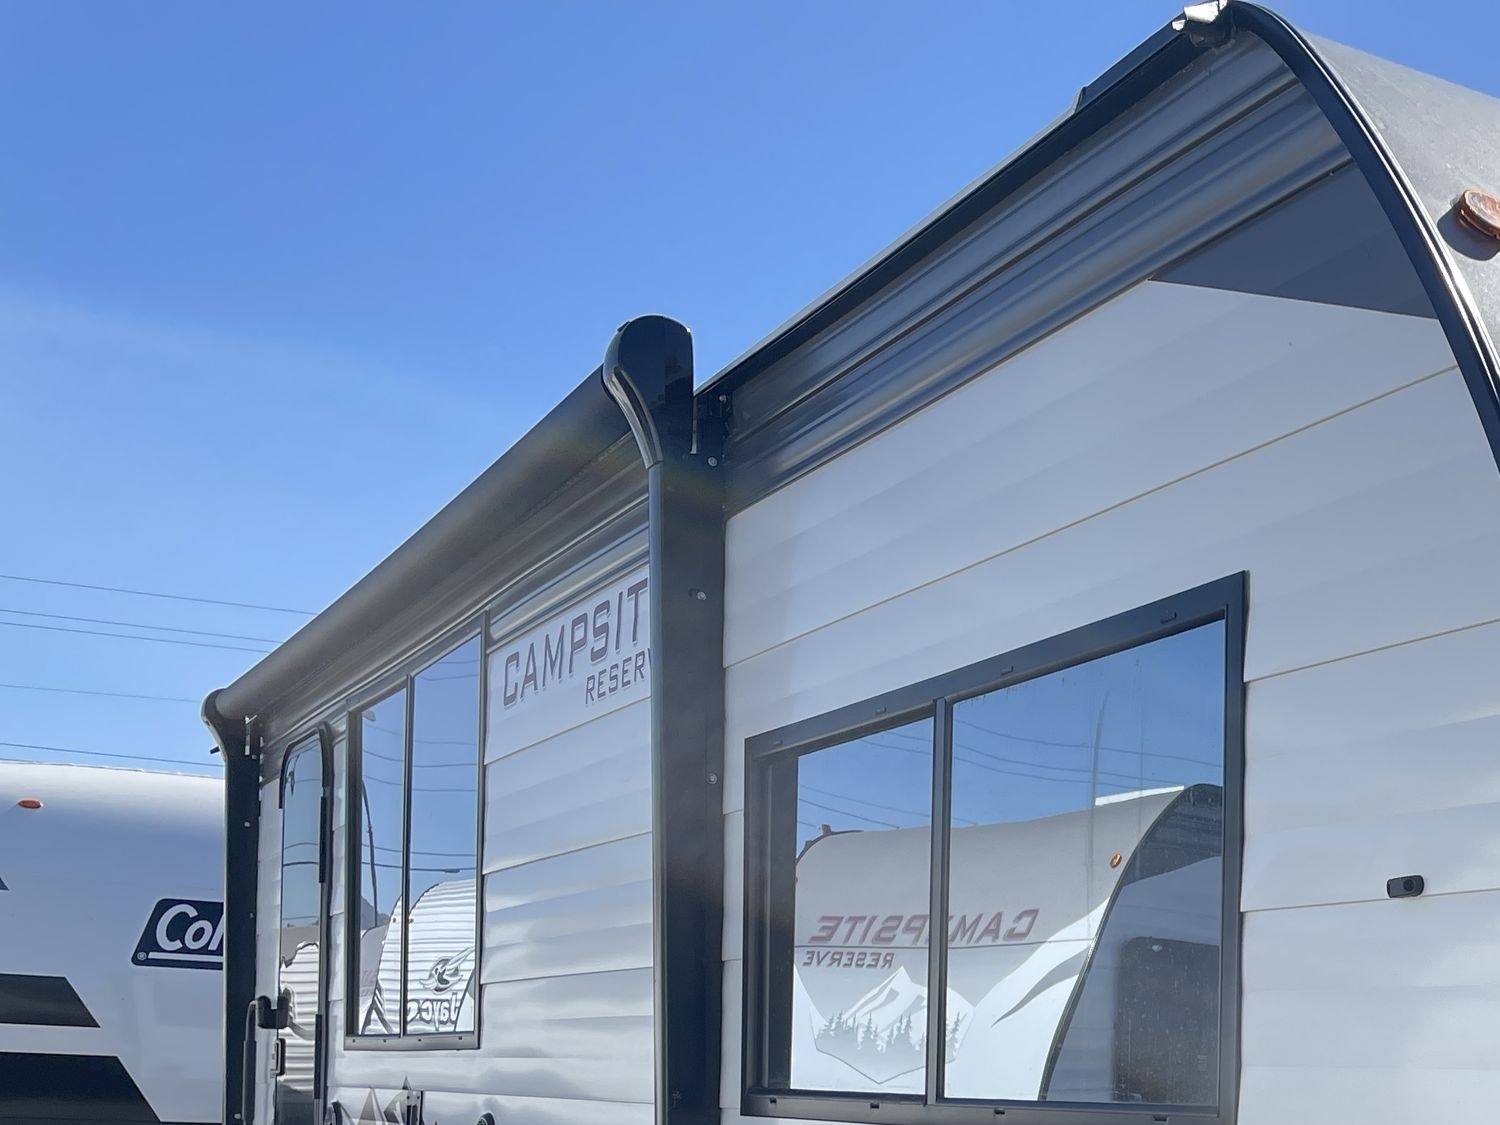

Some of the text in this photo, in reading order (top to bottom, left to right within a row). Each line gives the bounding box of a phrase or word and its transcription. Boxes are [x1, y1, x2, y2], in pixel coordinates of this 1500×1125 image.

[503, 576, 649, 708] CAMPSIT
[584, 647, 652, 706] RESER
[156, 903, 225, 951] Col
